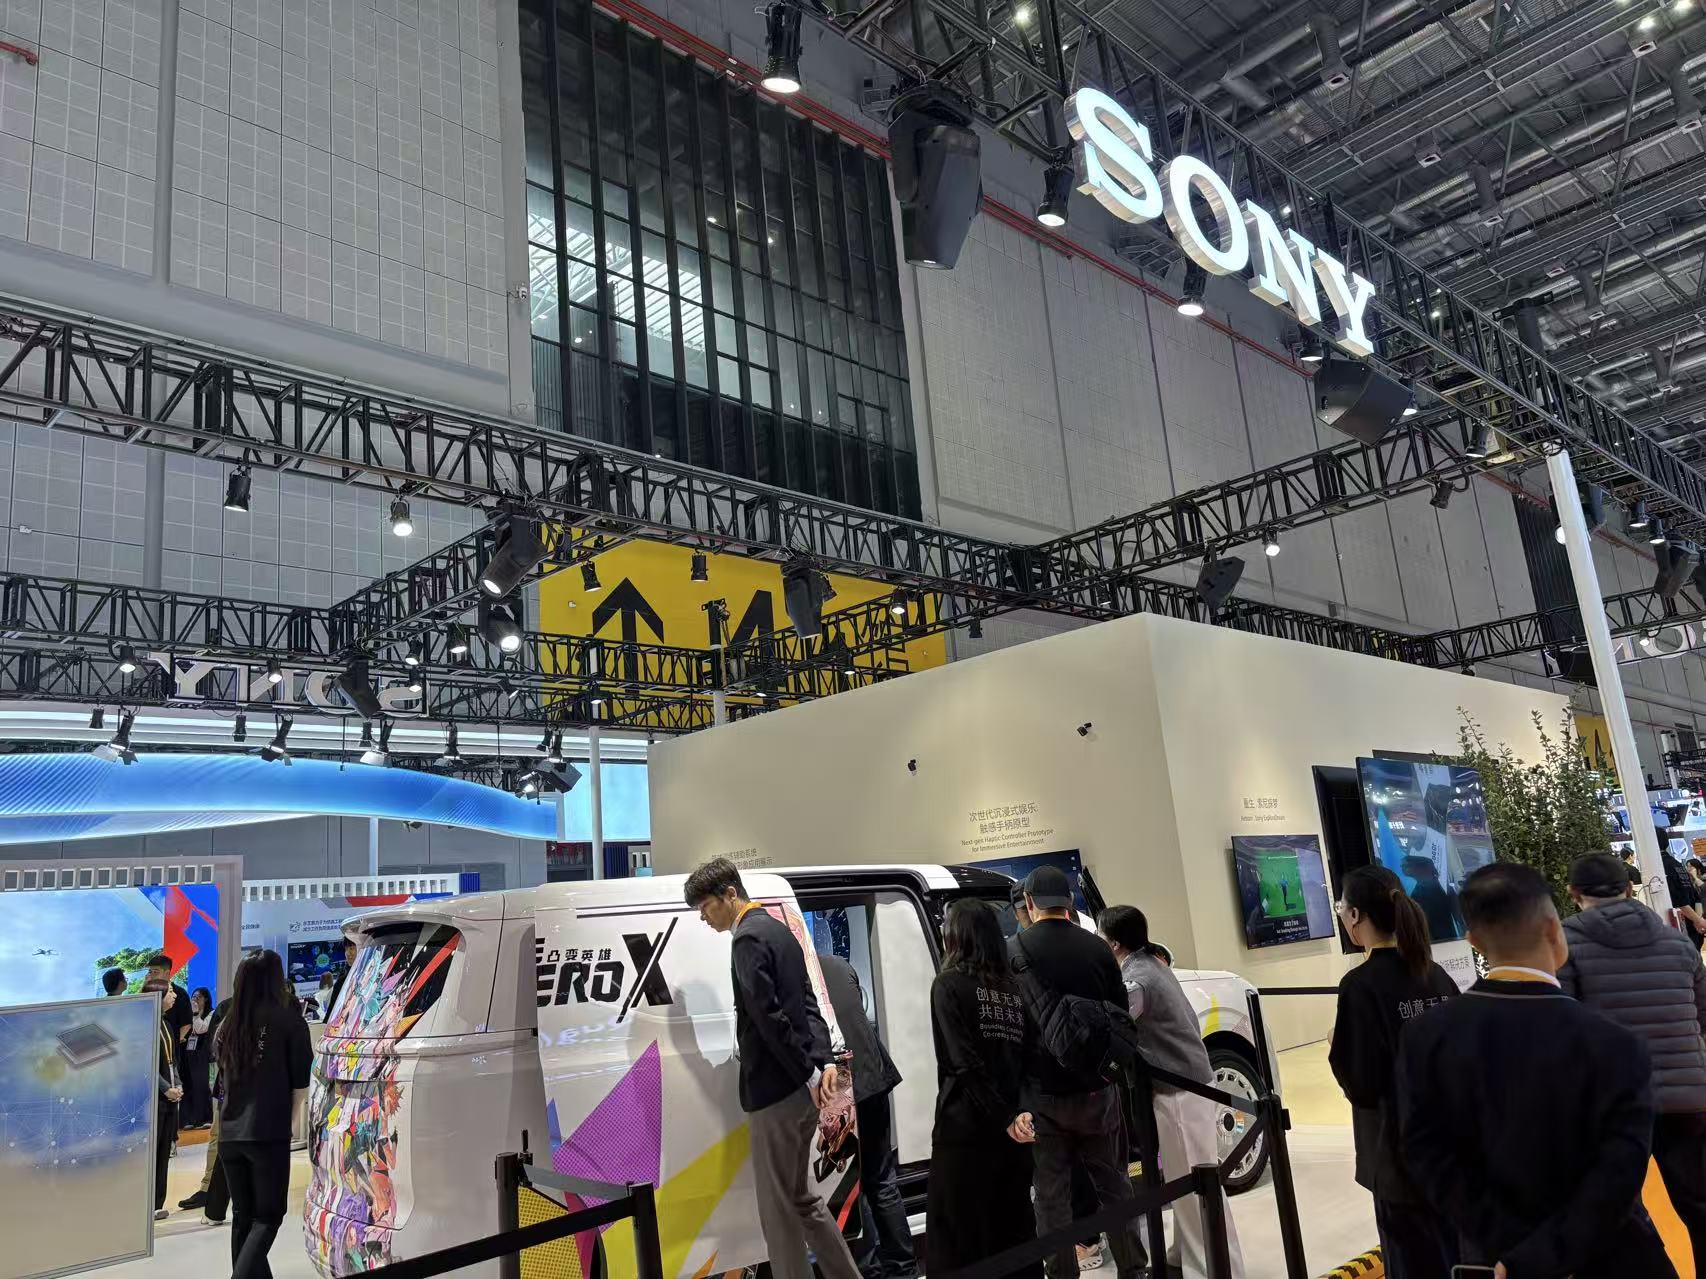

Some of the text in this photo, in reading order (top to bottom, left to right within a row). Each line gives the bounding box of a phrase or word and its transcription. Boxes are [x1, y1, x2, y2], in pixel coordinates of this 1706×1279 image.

[1065, 88, 1376, 356] SONY
[968, 802, 1039, 822] 次世代沉浸式娱乐
[979, 817, 1031, 834] 触感手柄原型
[1001, 831, 1027, 841] Controller
[1027, 827, 1054, 838] Prototype
[979, 843, 1006, 852] Immersive
[1006, 838, 1044, 849] Entertainment
[547, 948, 612, 963] 凸变英雄
[615, 917, 679, 1024] X
[976, 986, 1022, 1008] 创意无界
[979, 1004, 1024, 1027] 共启未来
